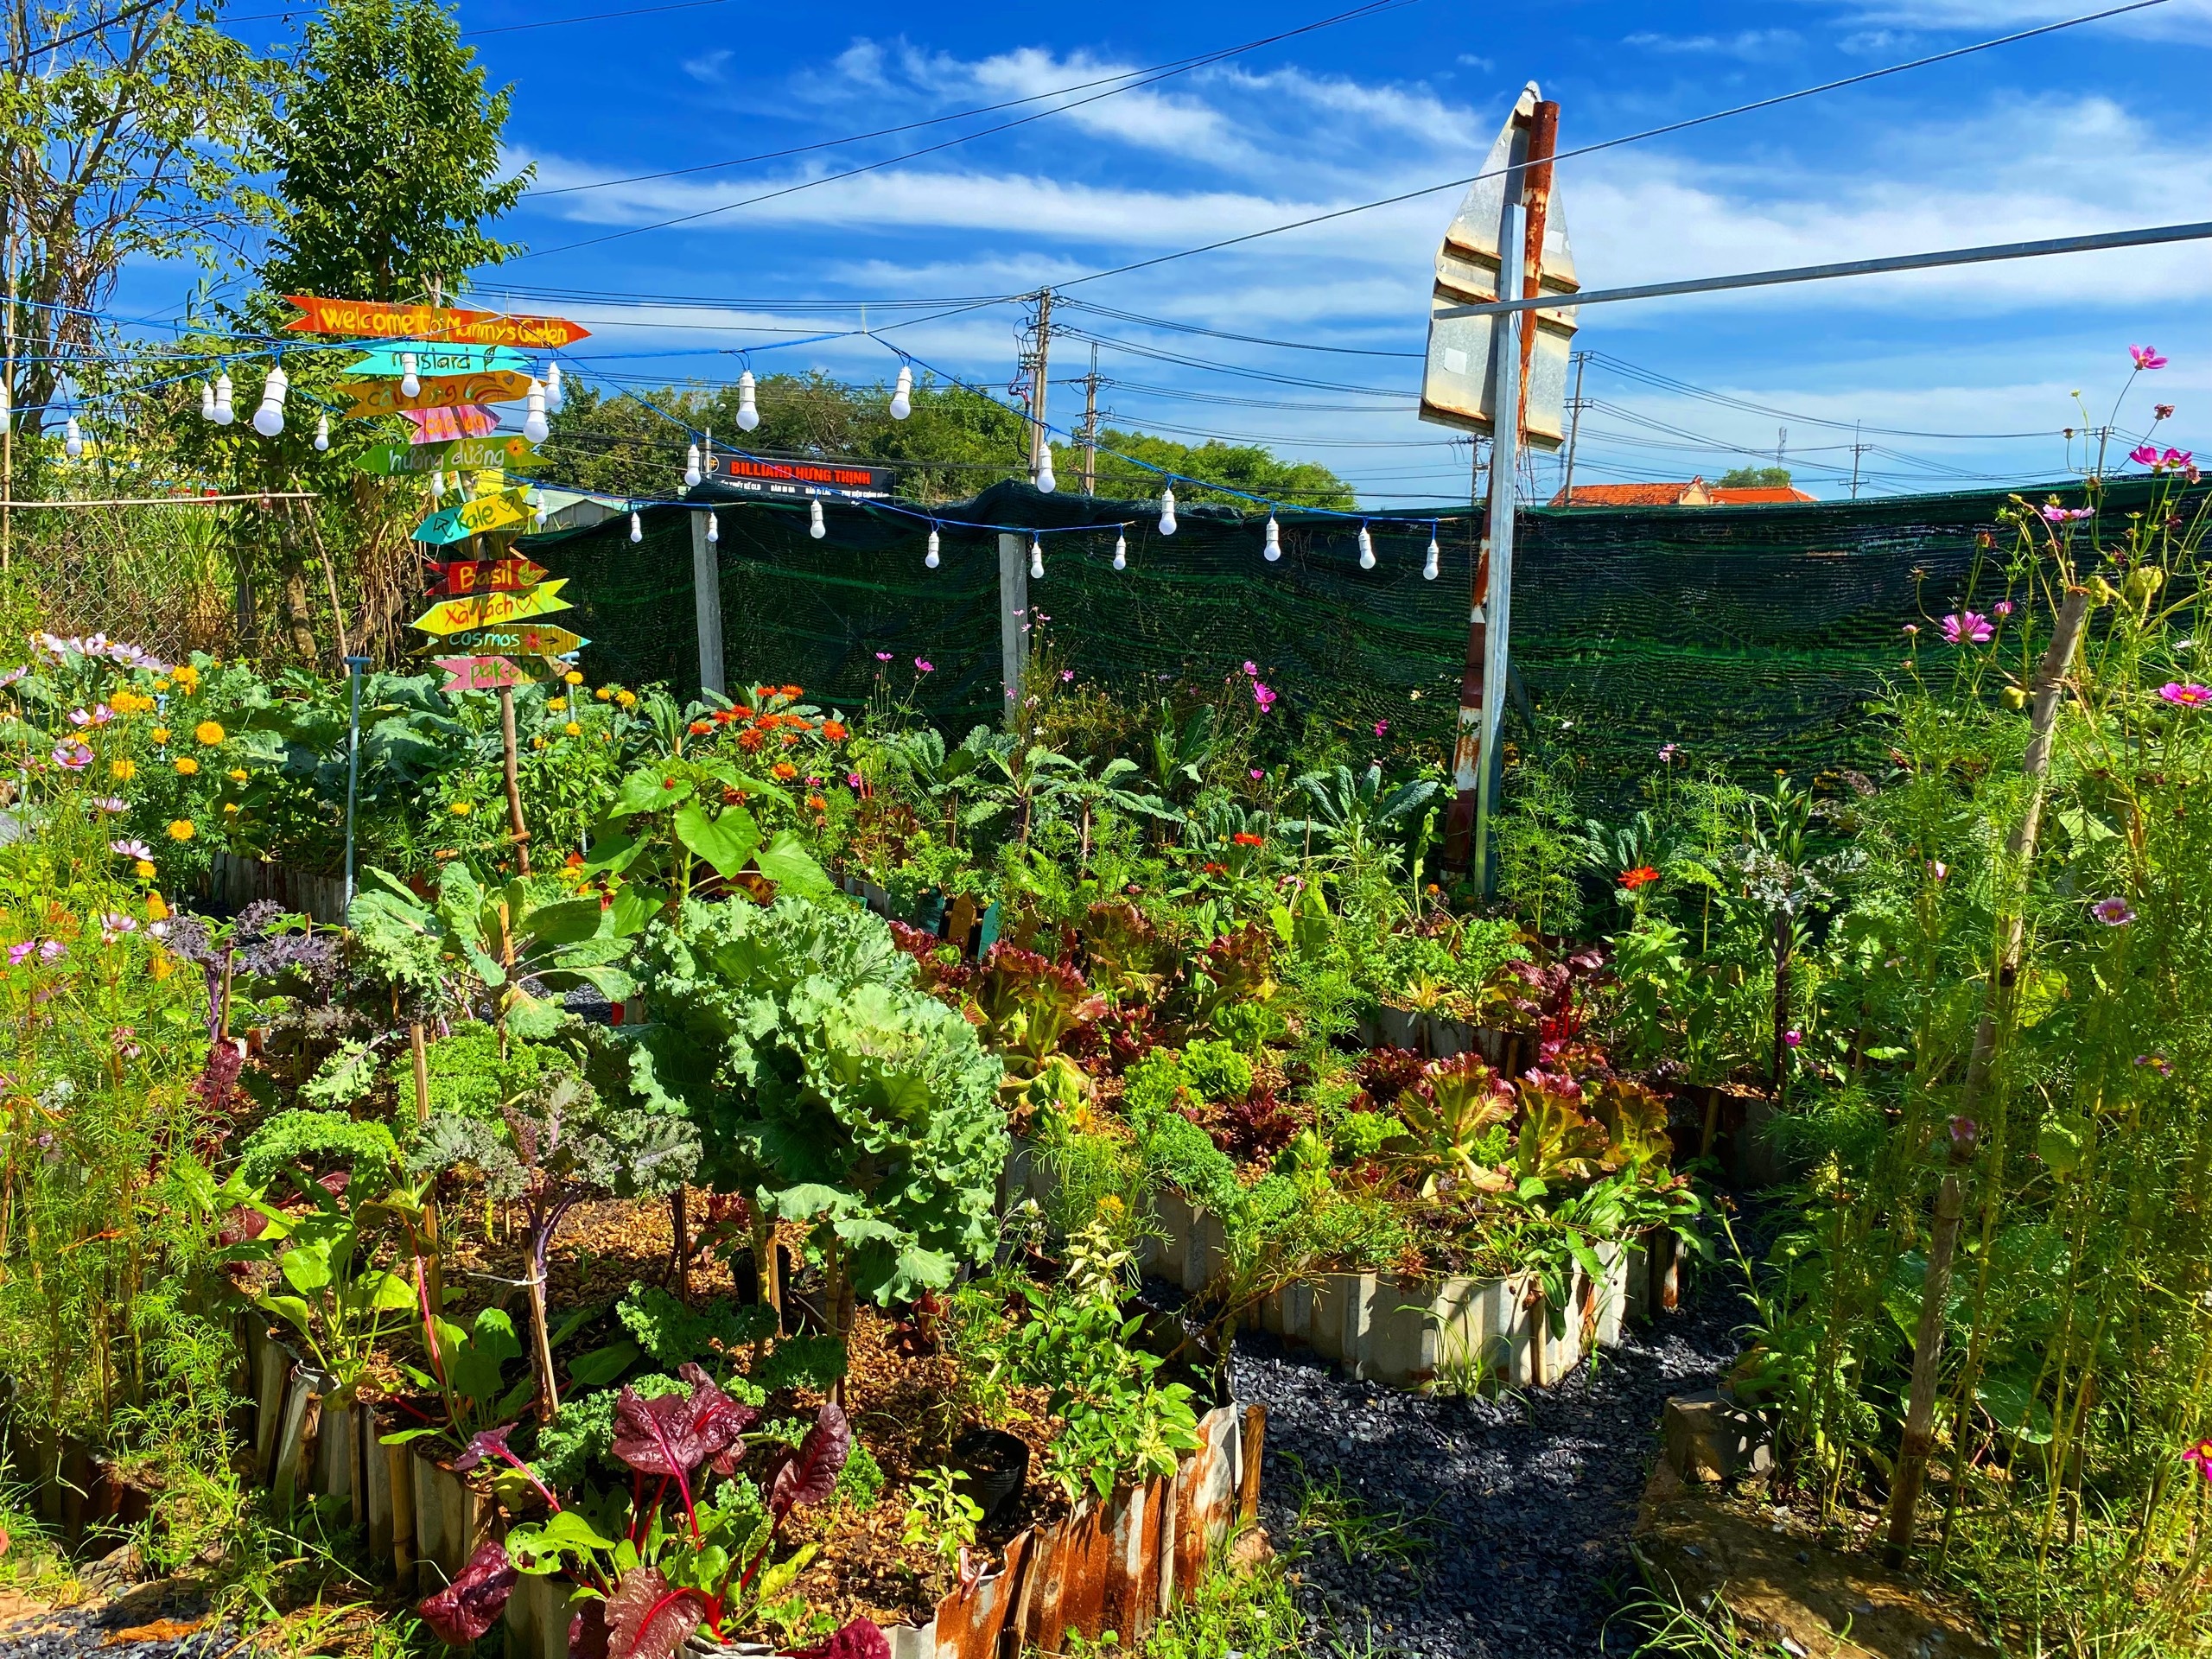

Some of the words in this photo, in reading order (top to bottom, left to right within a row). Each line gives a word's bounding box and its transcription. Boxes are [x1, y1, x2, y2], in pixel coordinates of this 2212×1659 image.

[416, 309, 442, 334] to
[518, 319, 568, 346] Garden
[730, 461, 792, 479] BILLIARD
[795, 467, 832, 482] HƯNG
[834, 469, 871, 486] THỊNH
[460, 560, 512, 590] Basil
[448, 632, 521, 648] cosmos
[470, 658, 505, 689] pak
